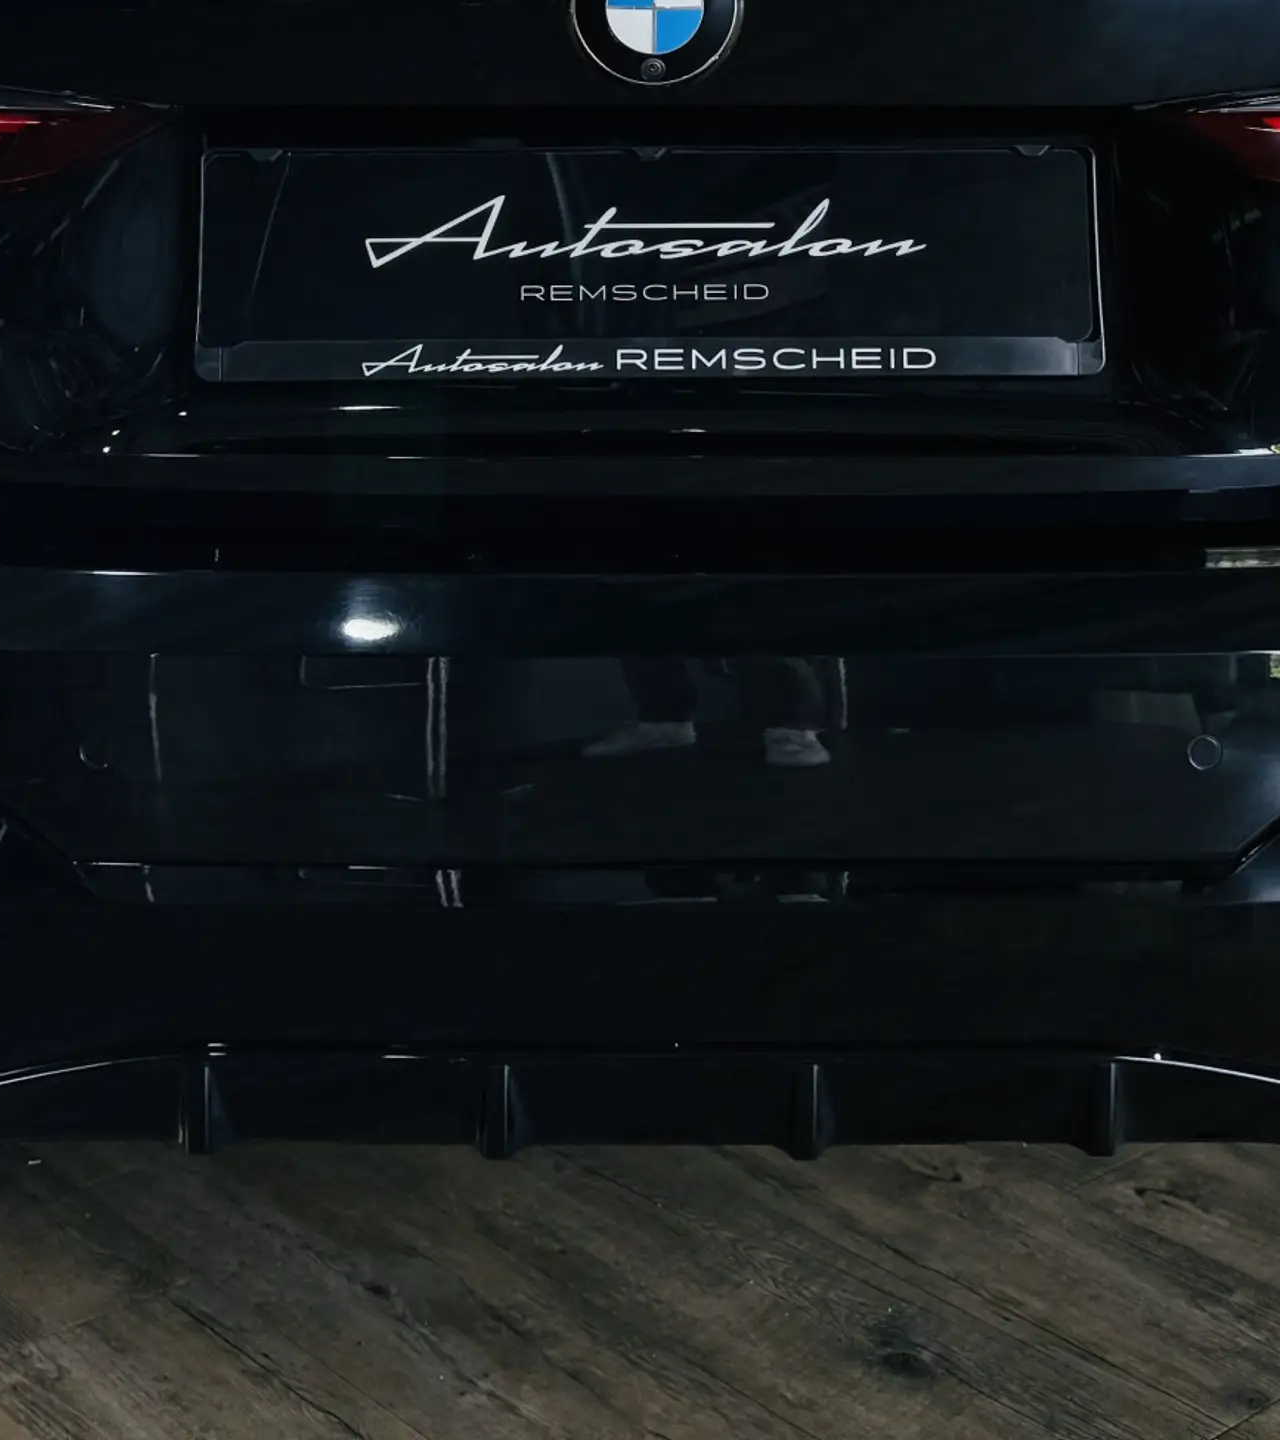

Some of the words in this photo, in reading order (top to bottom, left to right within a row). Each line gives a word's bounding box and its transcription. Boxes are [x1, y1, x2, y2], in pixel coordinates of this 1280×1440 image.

[365, 194, 927, 269] Autosalon
[520, 283, 770, 302] REMSCHEID
[362, 344, 605, 377] Autosalon
[616, 348, 937, 371] REMSCHEID
